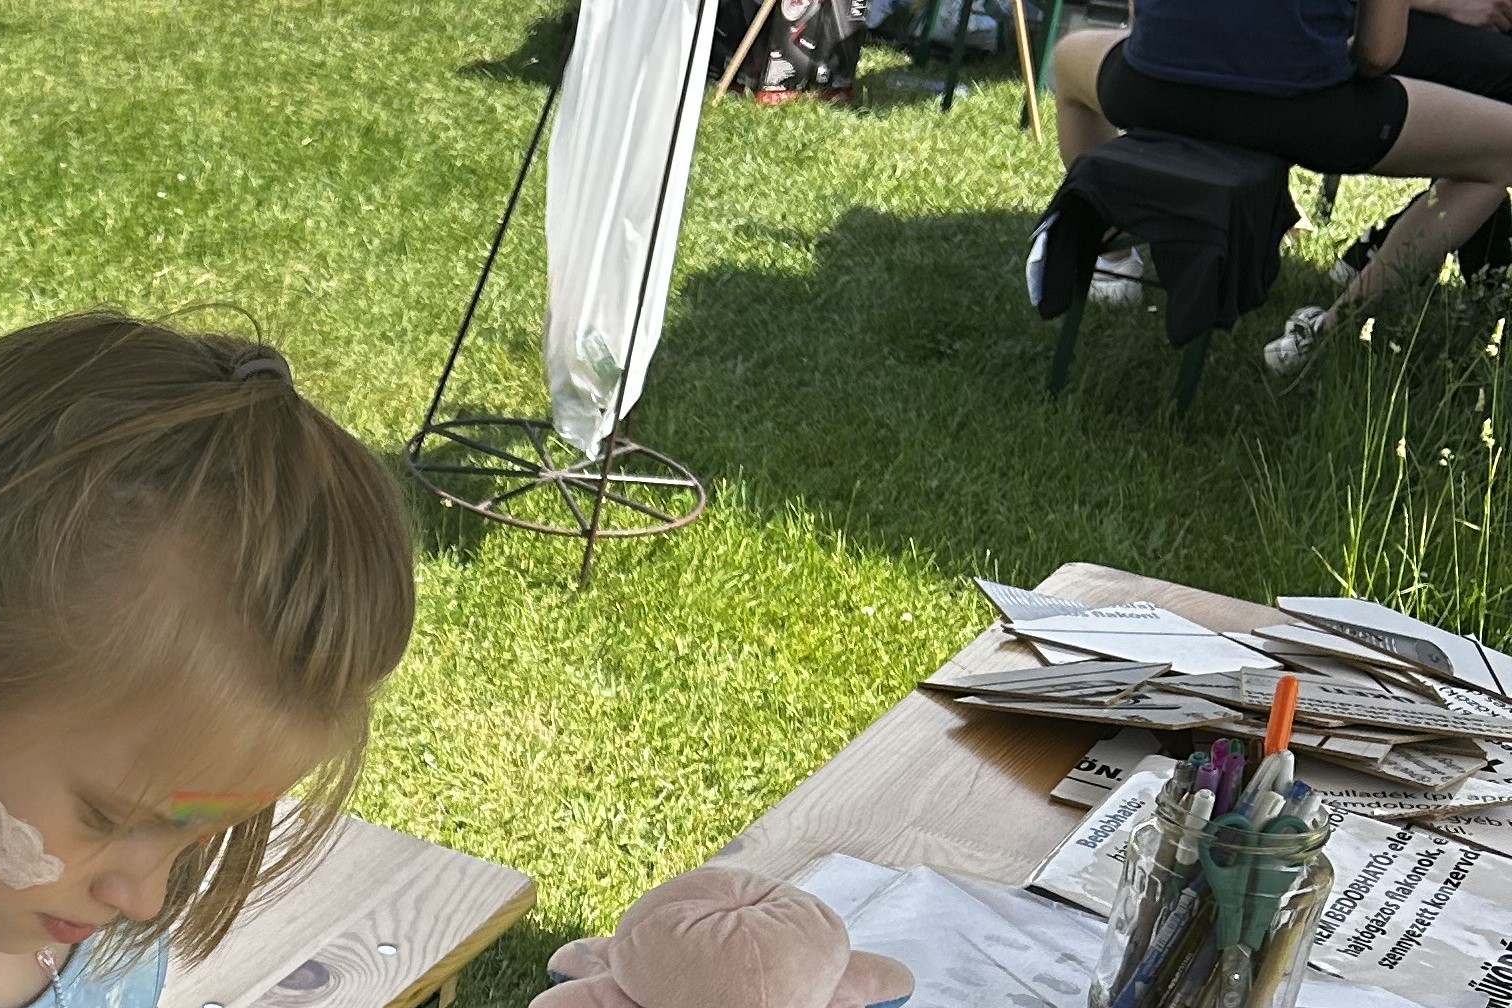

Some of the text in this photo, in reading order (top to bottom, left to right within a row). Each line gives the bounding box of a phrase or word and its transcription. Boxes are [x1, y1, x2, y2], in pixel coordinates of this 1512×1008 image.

[1076, 797, 1145, 850] Bedobható:
[1330, 850, 1398, 924] BEDOBHATÓ:
[1336, 900, 1401, 958] hajtógázos
[1385, 848, 1445, 903] flakonok,
[1377, 848, 1481, 970] szennyezett konzervd
